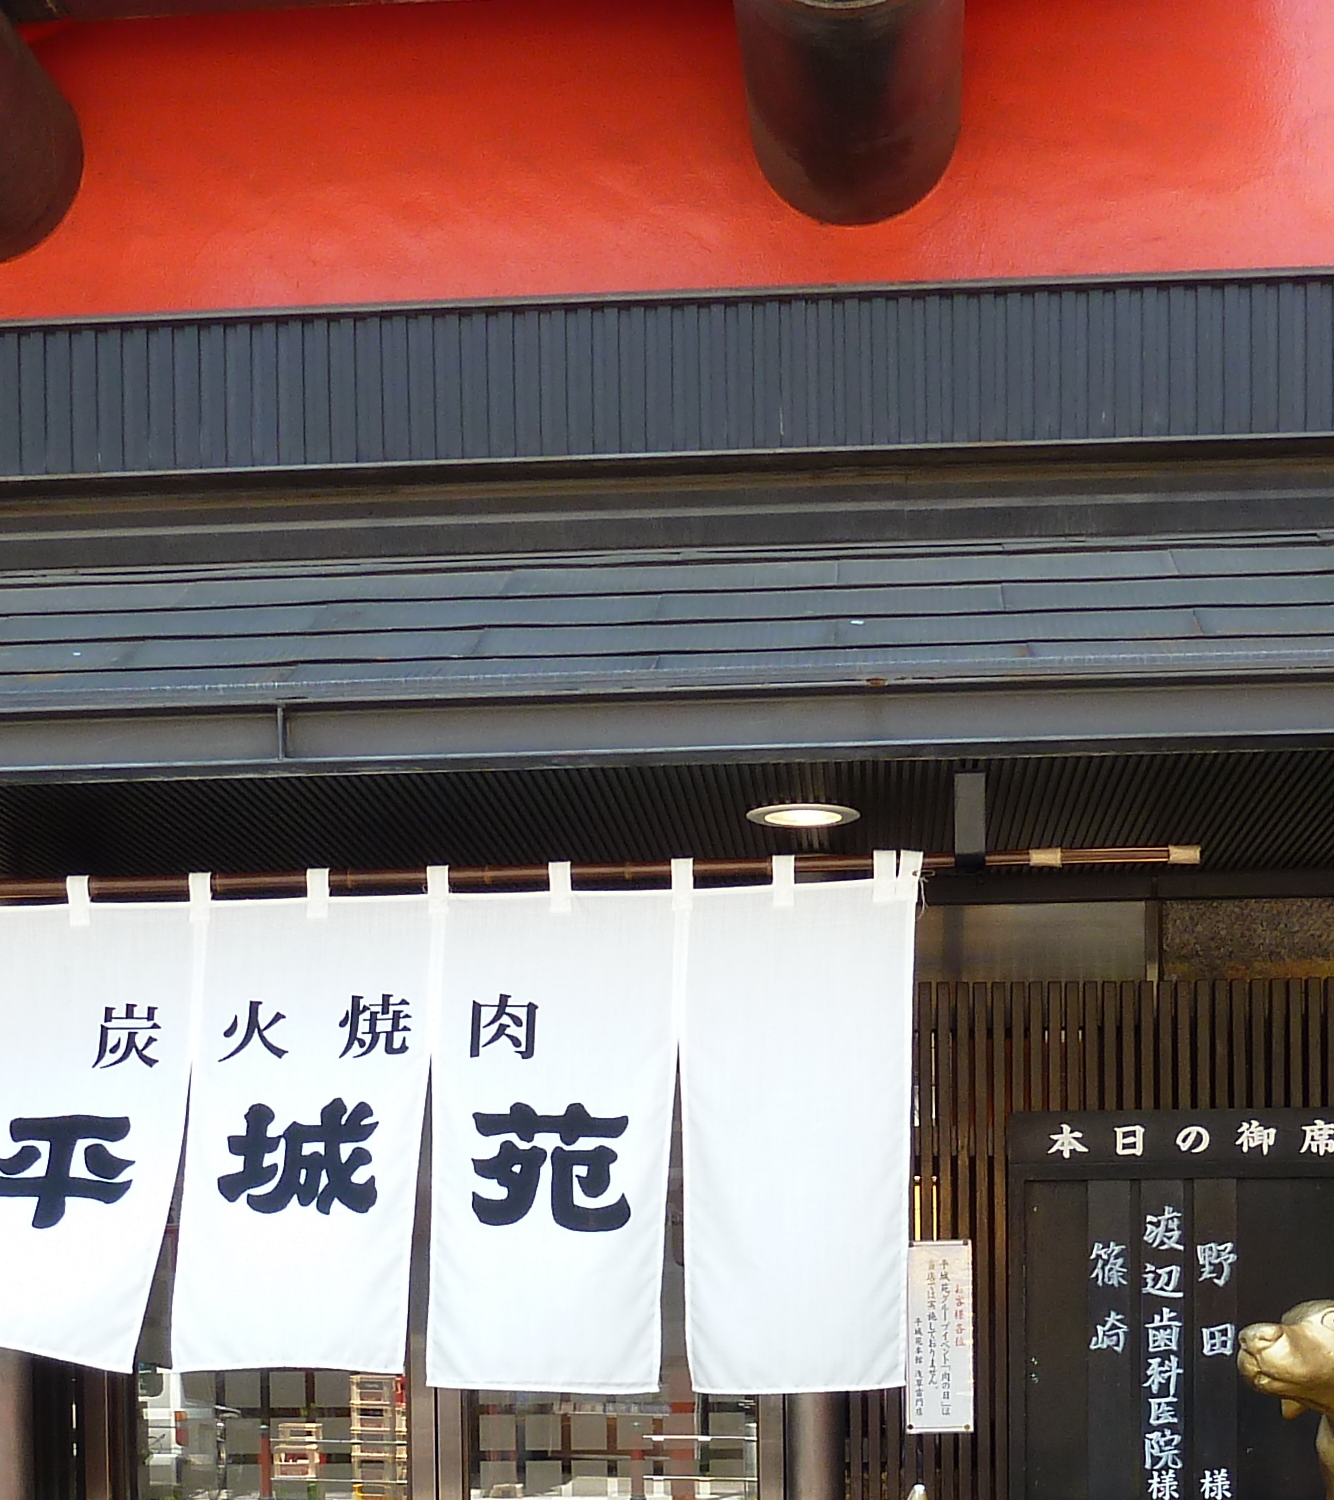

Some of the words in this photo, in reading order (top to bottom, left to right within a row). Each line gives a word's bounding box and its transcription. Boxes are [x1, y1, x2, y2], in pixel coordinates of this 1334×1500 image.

[91, 993, 539, 1069] 炭火焼肉
[954, 1284, 967, 1348] お客様各位
[1088, 1242, 1129, 1354] 篠崎
[1195, 1242, 1238, 1357] 野田
[1199, 1470, 1233, 1500] 様
